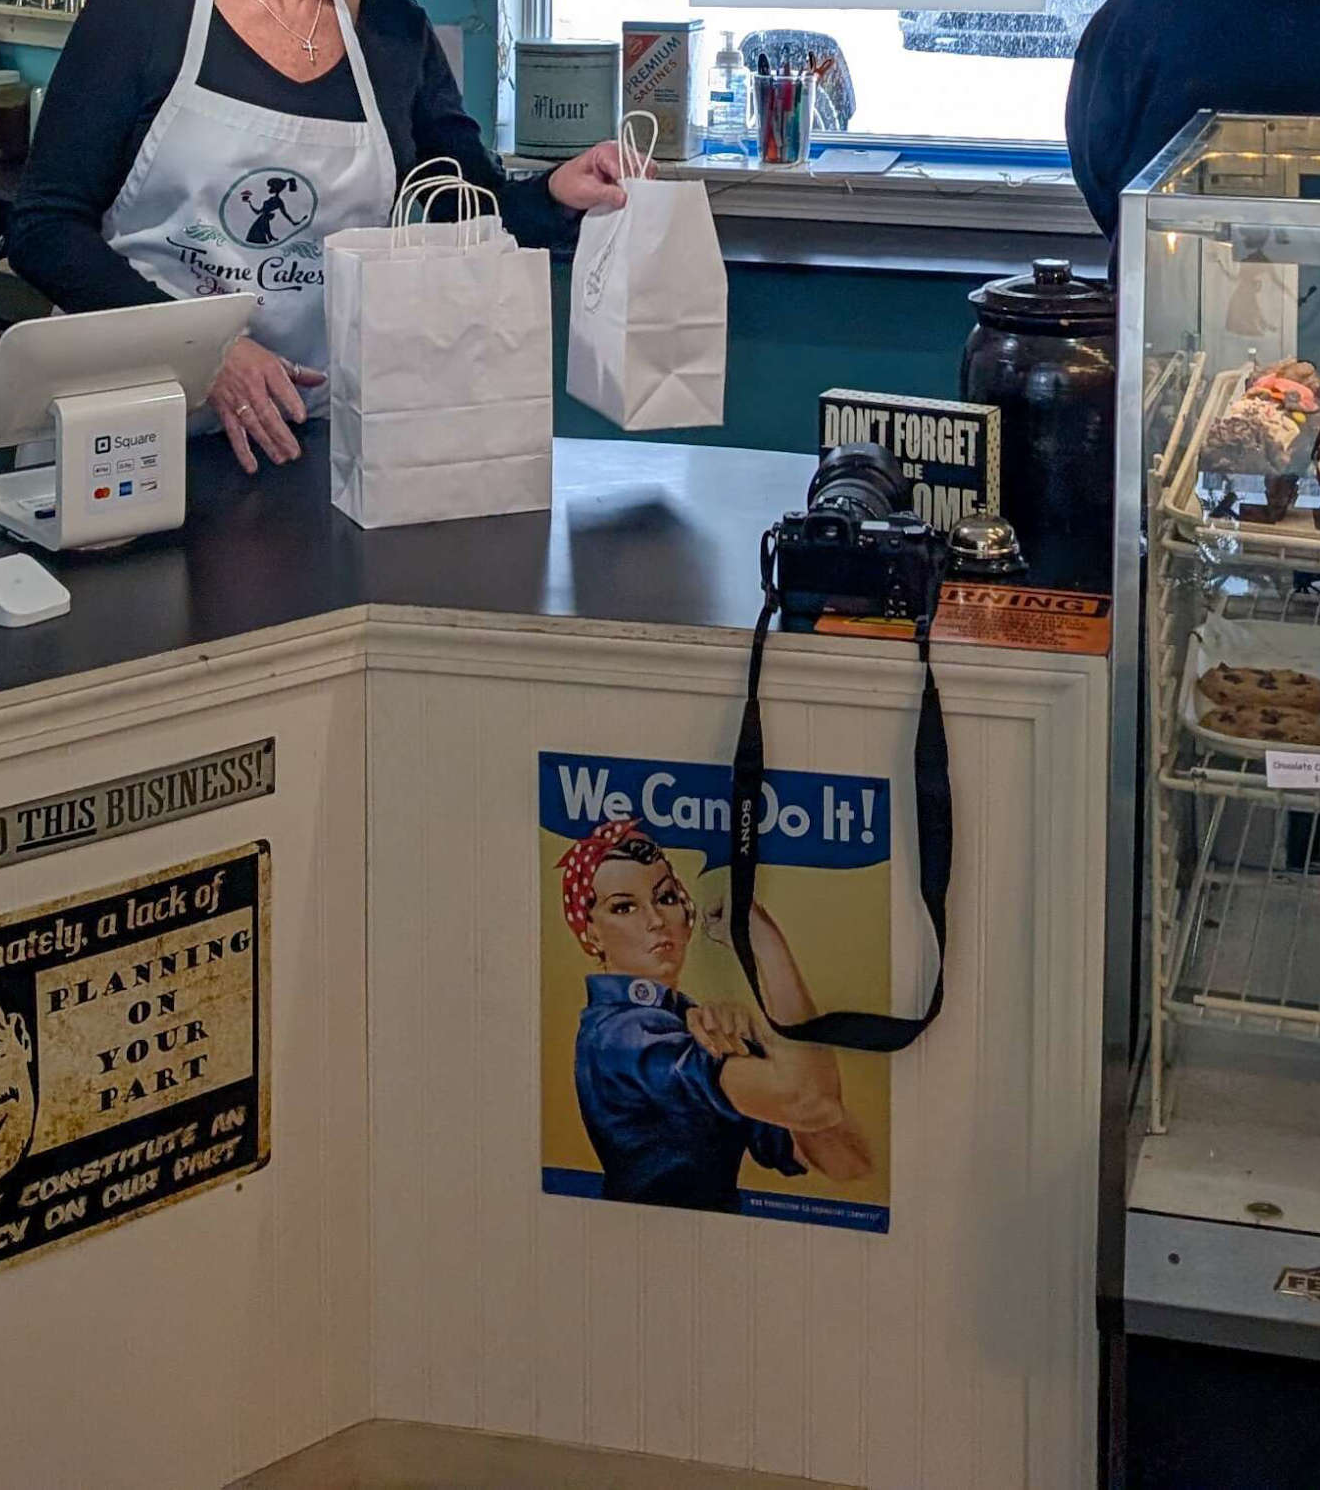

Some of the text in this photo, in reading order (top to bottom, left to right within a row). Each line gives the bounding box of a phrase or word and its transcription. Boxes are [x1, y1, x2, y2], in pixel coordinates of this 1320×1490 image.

[624, 36, 682, 96] PREMIUM
[634, 61, 678, 103] SALTINES
[532, 94, 589, 120] Flour
[166, 237, 253, 281] Theme
[257, 256, 324, 292] Cakes
[115, 433, 158, 449] Square
[824, 403, 980, 467] DON'T FORGET
[902, 462, 924, 480] BE
[947, 588, 1085, 612] RNING
[17, 796, 97, 845] THIS
[105, 752, 264, 830] BUSINESS!
[558, 765, 633, 822] We
[641, 772, 730, 832] Can
[822, 785, 876, 845] It!
[741, 799, 752, 856] SONY
[96, 913, 118, 940] a
[127, 884, 187, 933] lack
[194, 870, 227, 914] of
[45, 927, 251, 1015] PLANNING
[127, 989, 179, 1026] ON
[95, 1020, 210, 1075] YOUR
[97, 1053, 209, 1111] PART
[17, 1122, 200, 1208] CONSTITUTE
[210, 1105, 248, 1138] AN
[44, 1196, 89, 1231] ON
[101, 1172, 161, 1210] OUR
[171, 1135, 243, 1181] PART
